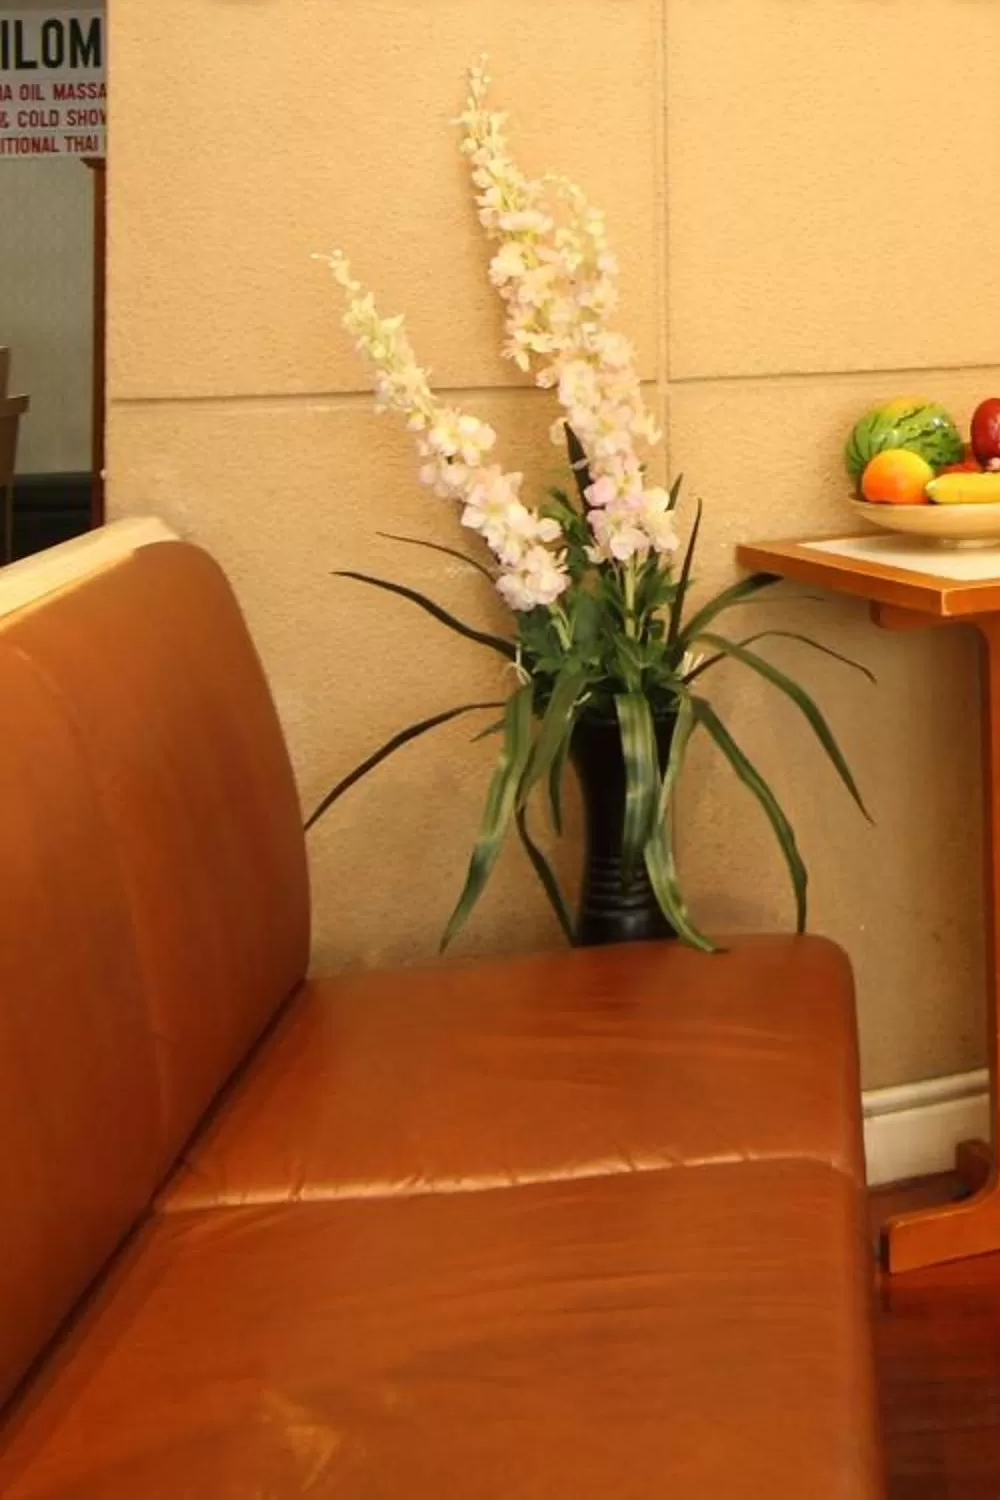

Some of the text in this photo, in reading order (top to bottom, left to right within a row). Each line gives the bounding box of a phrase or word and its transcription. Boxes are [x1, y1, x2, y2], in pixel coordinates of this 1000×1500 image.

[19, 84, 45, 101] OIL
[17, 109, 60, 127] COLD
[64, 134, 99, 151] THAI
